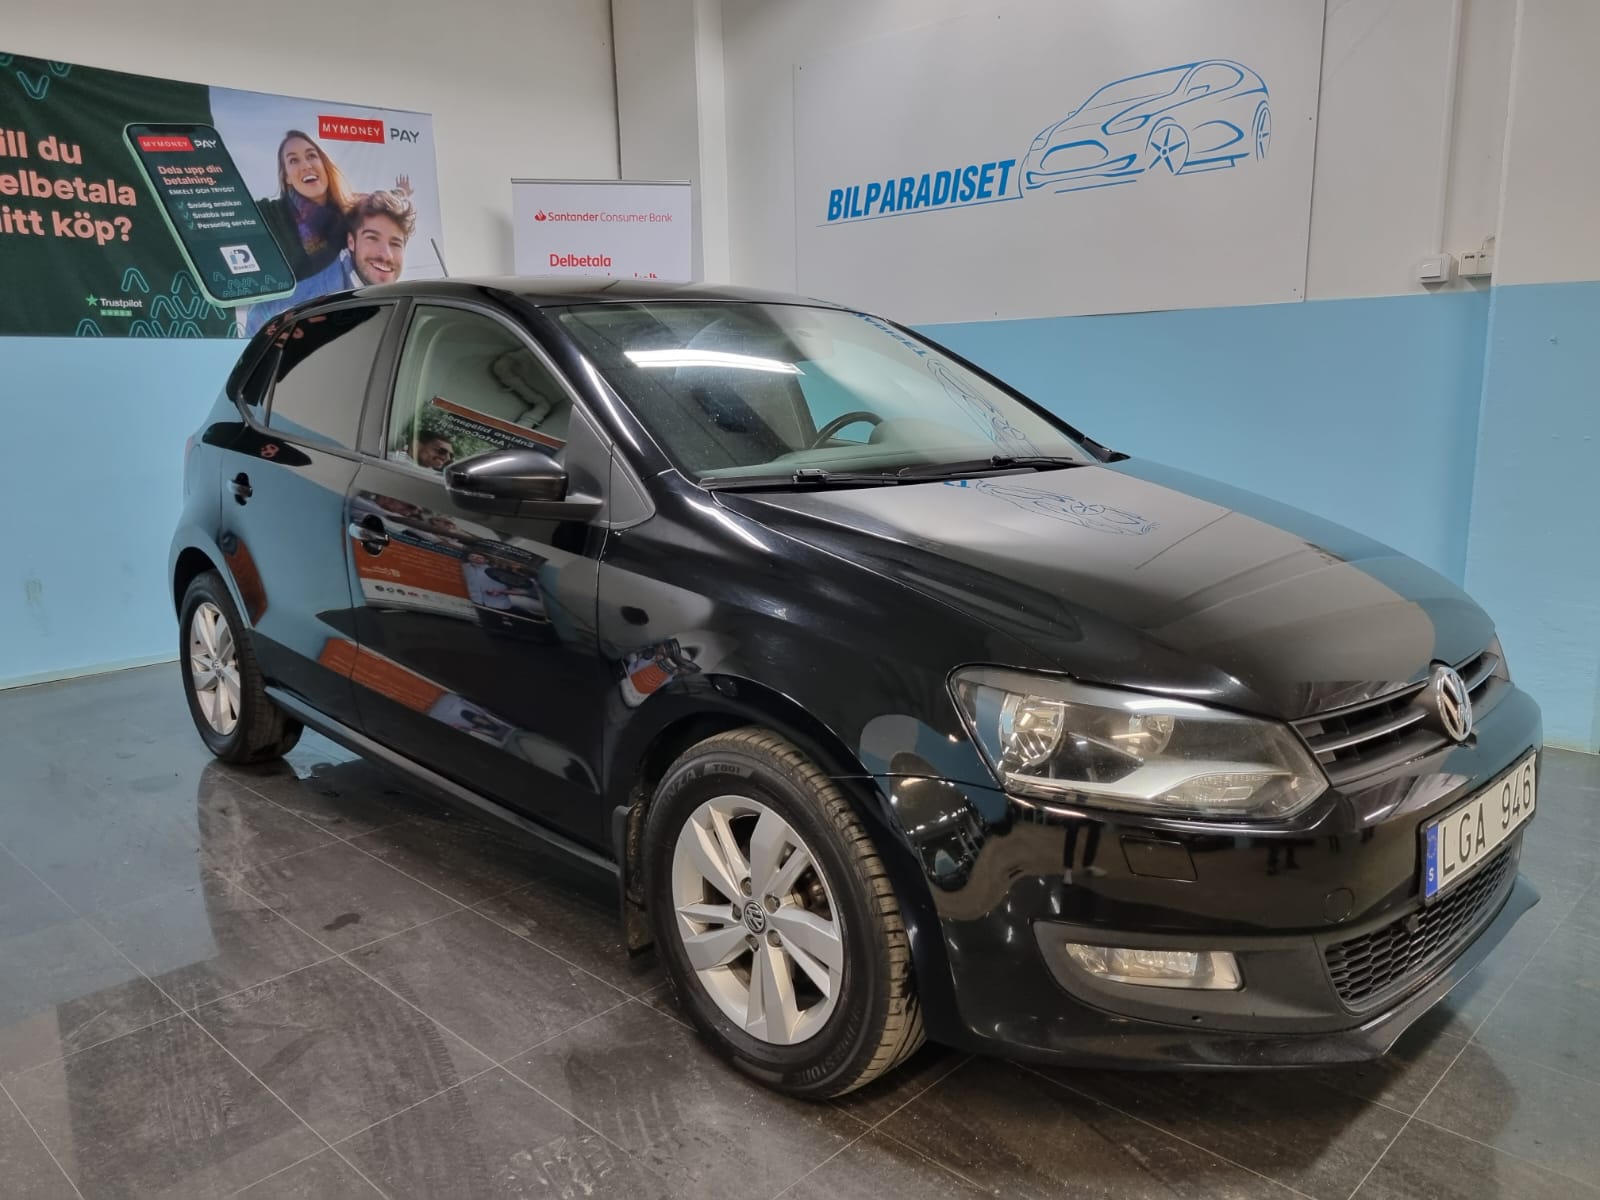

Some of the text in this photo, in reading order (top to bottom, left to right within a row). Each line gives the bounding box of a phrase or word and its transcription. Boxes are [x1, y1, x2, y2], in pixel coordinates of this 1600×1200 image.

[322, 123, 420, 143] MYMONEY PAY
[38, 135, 82, 165] du
[193, 139, 217, 148] PAY
[157, 165, 223, 175] Dela upp din
[0, 170, 137, 206] elbetala
[827, 159, 1016, 222] BILPARADISET
[0, 205, 132, 246] itt köp?
[548, 212, 673, 223] Santander Consumer Bank
[549, 254, 612, 268] Delbetala
[100, 298, 144, 308] Trustpilot
[1441, 763, 1532, 878] LGA 946
[1428, 867, 1435, 883] S
